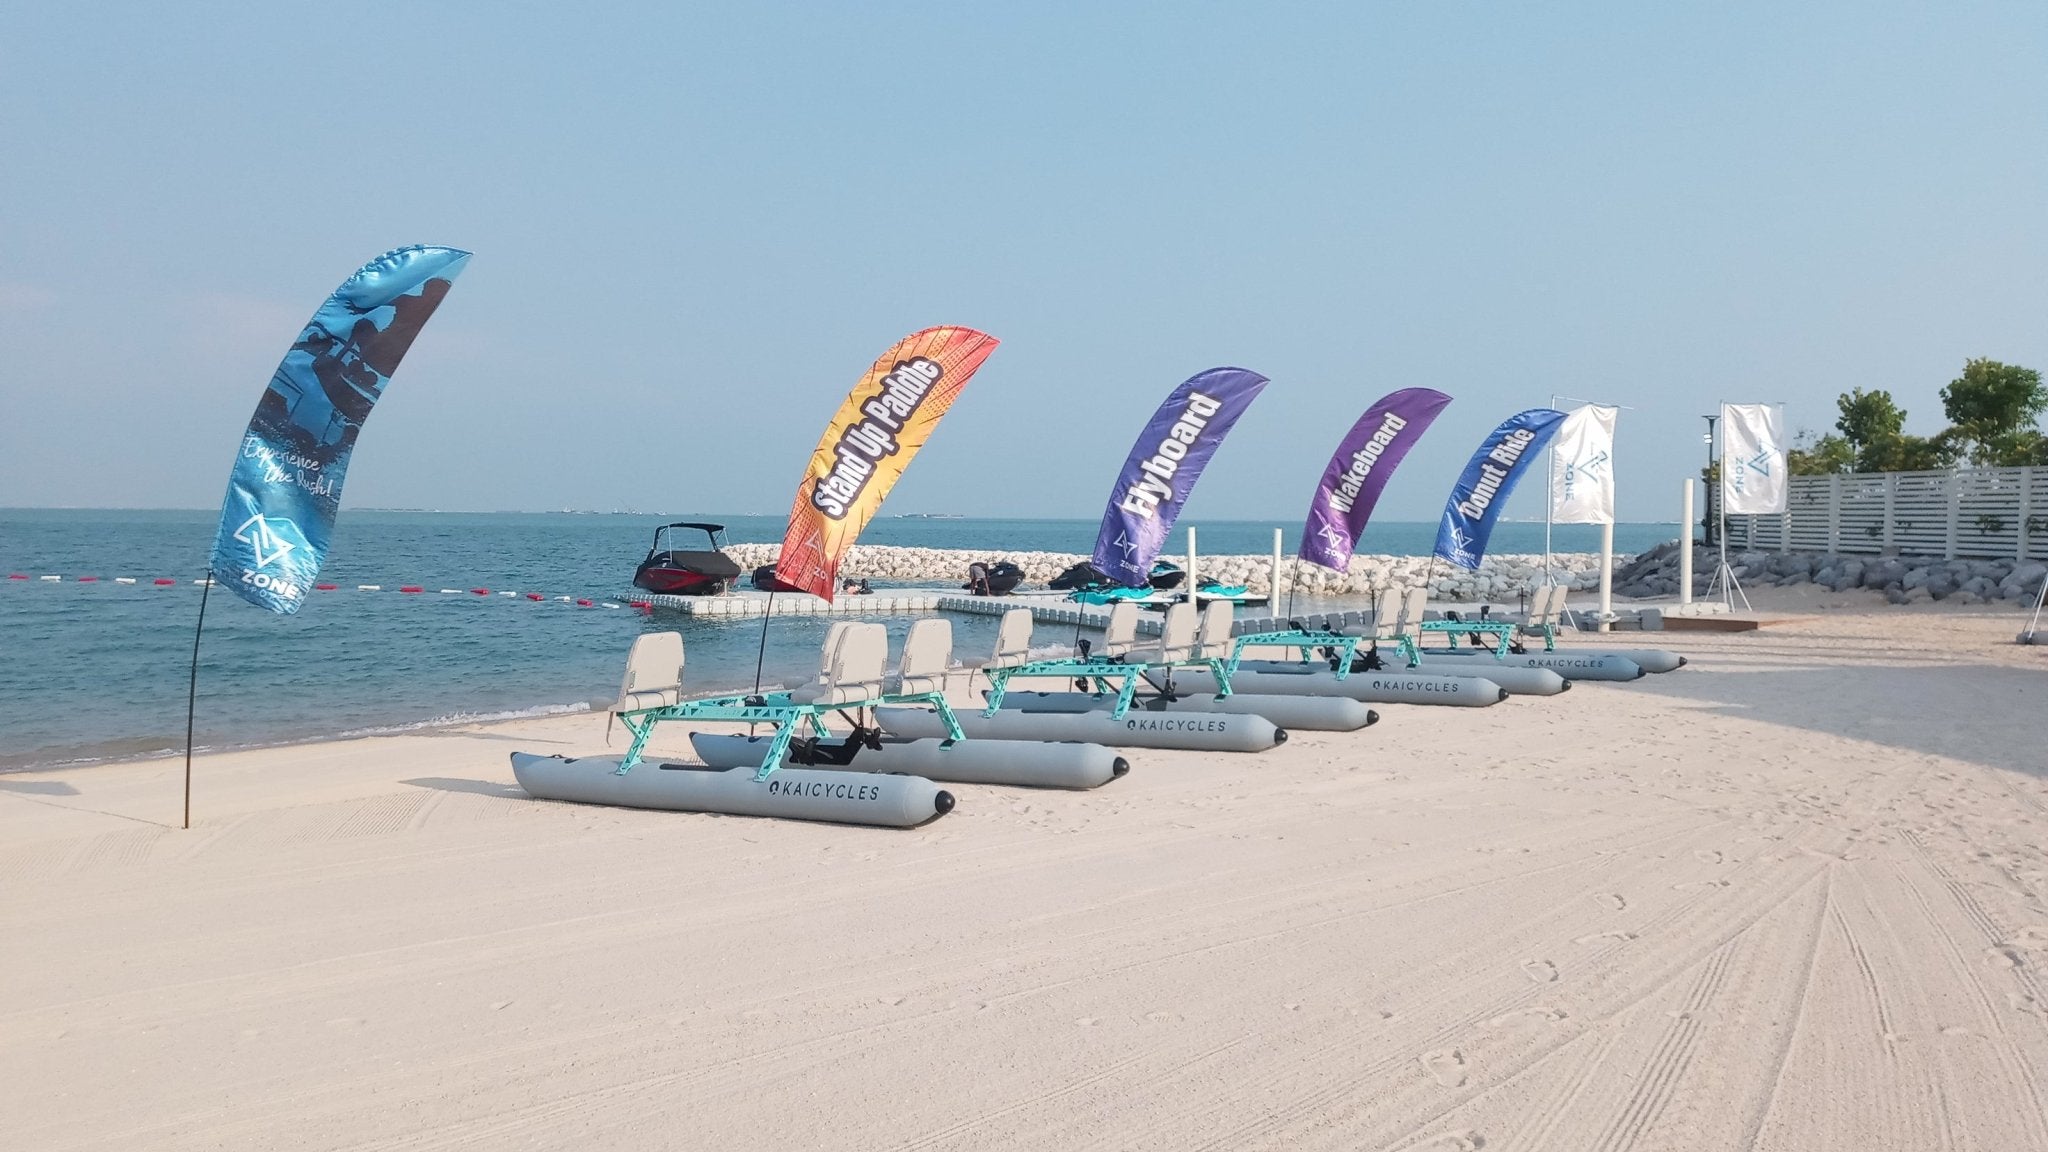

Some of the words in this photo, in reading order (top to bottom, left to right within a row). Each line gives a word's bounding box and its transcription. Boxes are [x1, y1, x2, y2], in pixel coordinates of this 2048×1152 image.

[865, 359, 939, 429] Paddle
[243, 436, 321, 469] Experience
[846, 423, 895, 457] Up
[1121, 391, 1222, 519] Flyboard
[1329, 412, 1408, 513] Wakeboard
[1458, 463, 1507, 521] Donut
[1489, 428, 1536, 468] Ride
[814, 447, 873, 516] Stand
[1120, 559, 1140, 574] ZONE
[1324, 547, 1347, 562] ZO
[241, 568, 300, 600] ZONE
[813, 566, 826, 580] ZO
[1537, 659, 1605, 668] KAICYCLES
[1383, 680, 1459, 692] KAICYCLES
[1140, 719, 1226, 732] KAICYCLES
[782, 781, 880, 801] KAICYCLES
